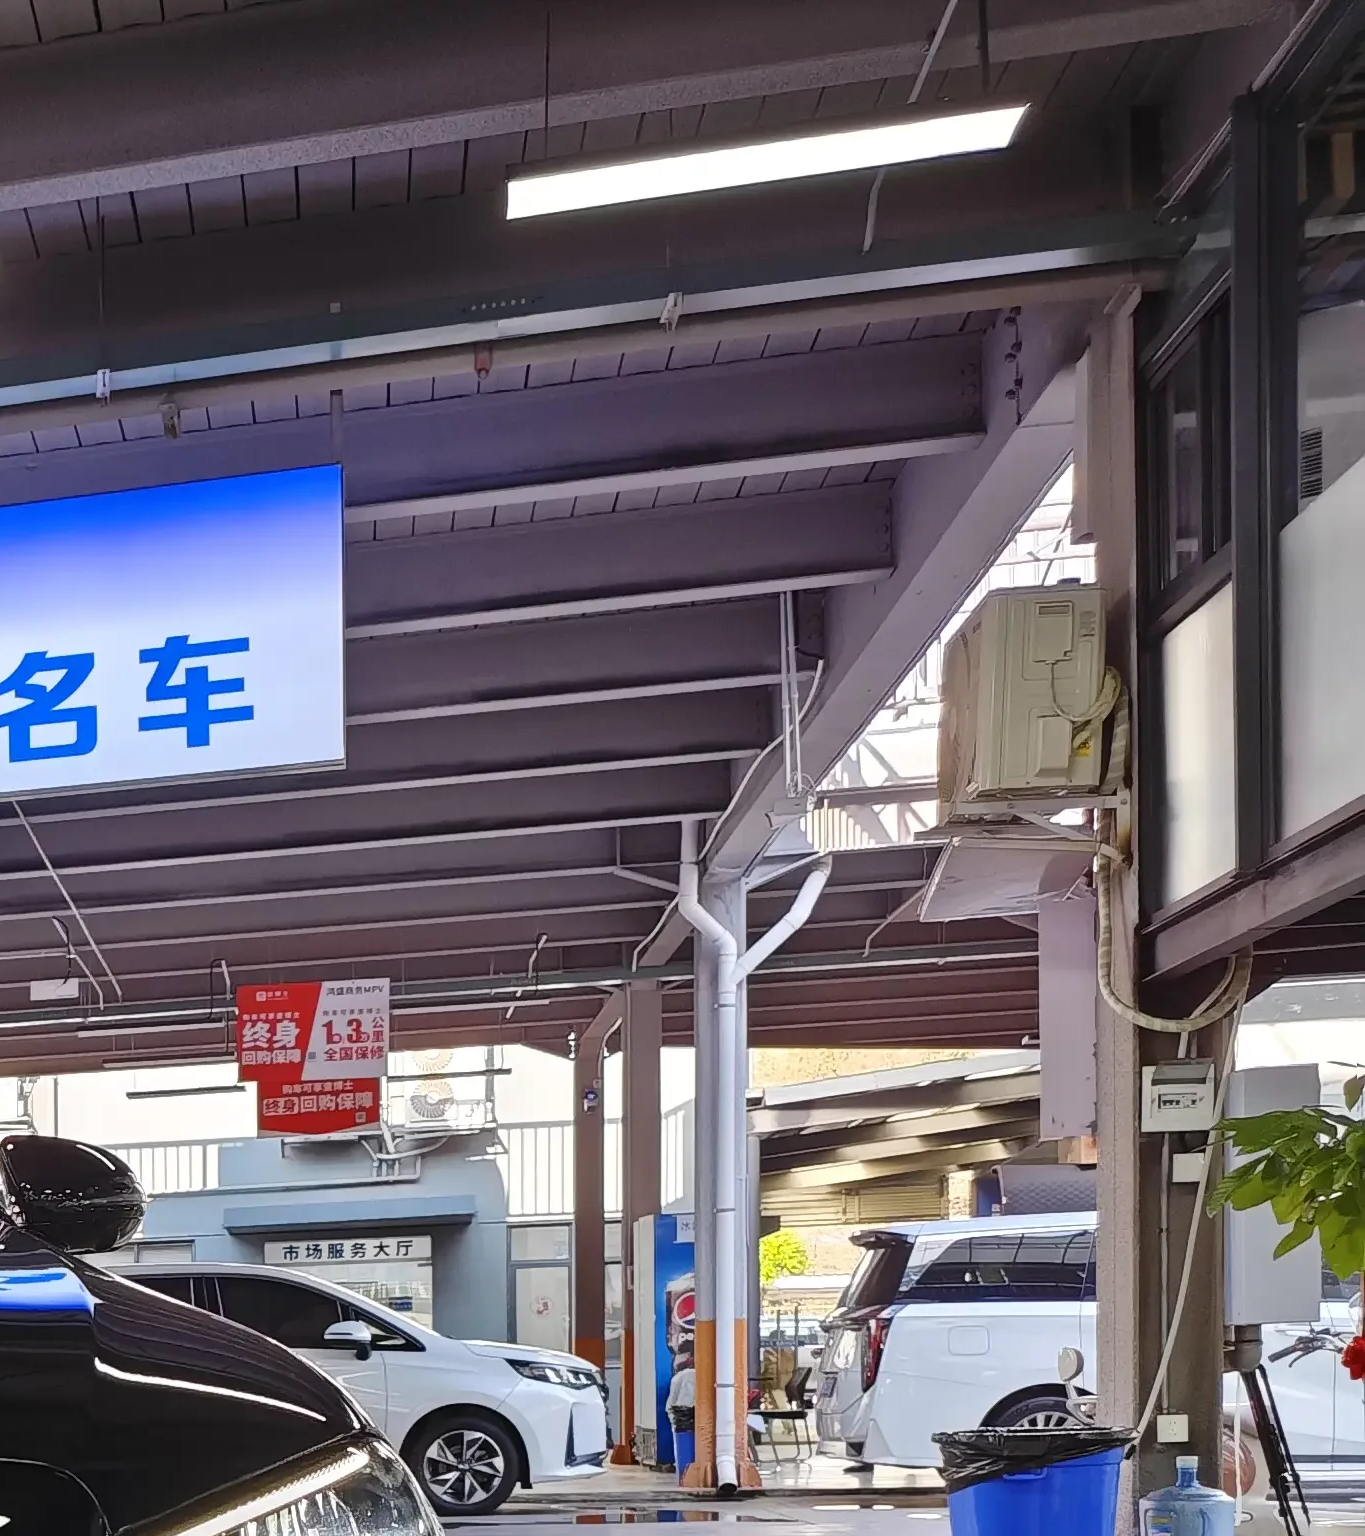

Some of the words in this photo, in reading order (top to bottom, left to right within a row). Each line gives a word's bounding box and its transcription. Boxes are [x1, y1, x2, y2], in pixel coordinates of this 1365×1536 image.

[242, 1019, 300, 1049] 终身
[241, 1049, 302, 1066] 回购保障
[323, 1045, 385, 1062] 全国保修
[264, 1091, 374, 1115] 终身回购保障
[282, 1239, 414, 1262] 市场服务大厅
